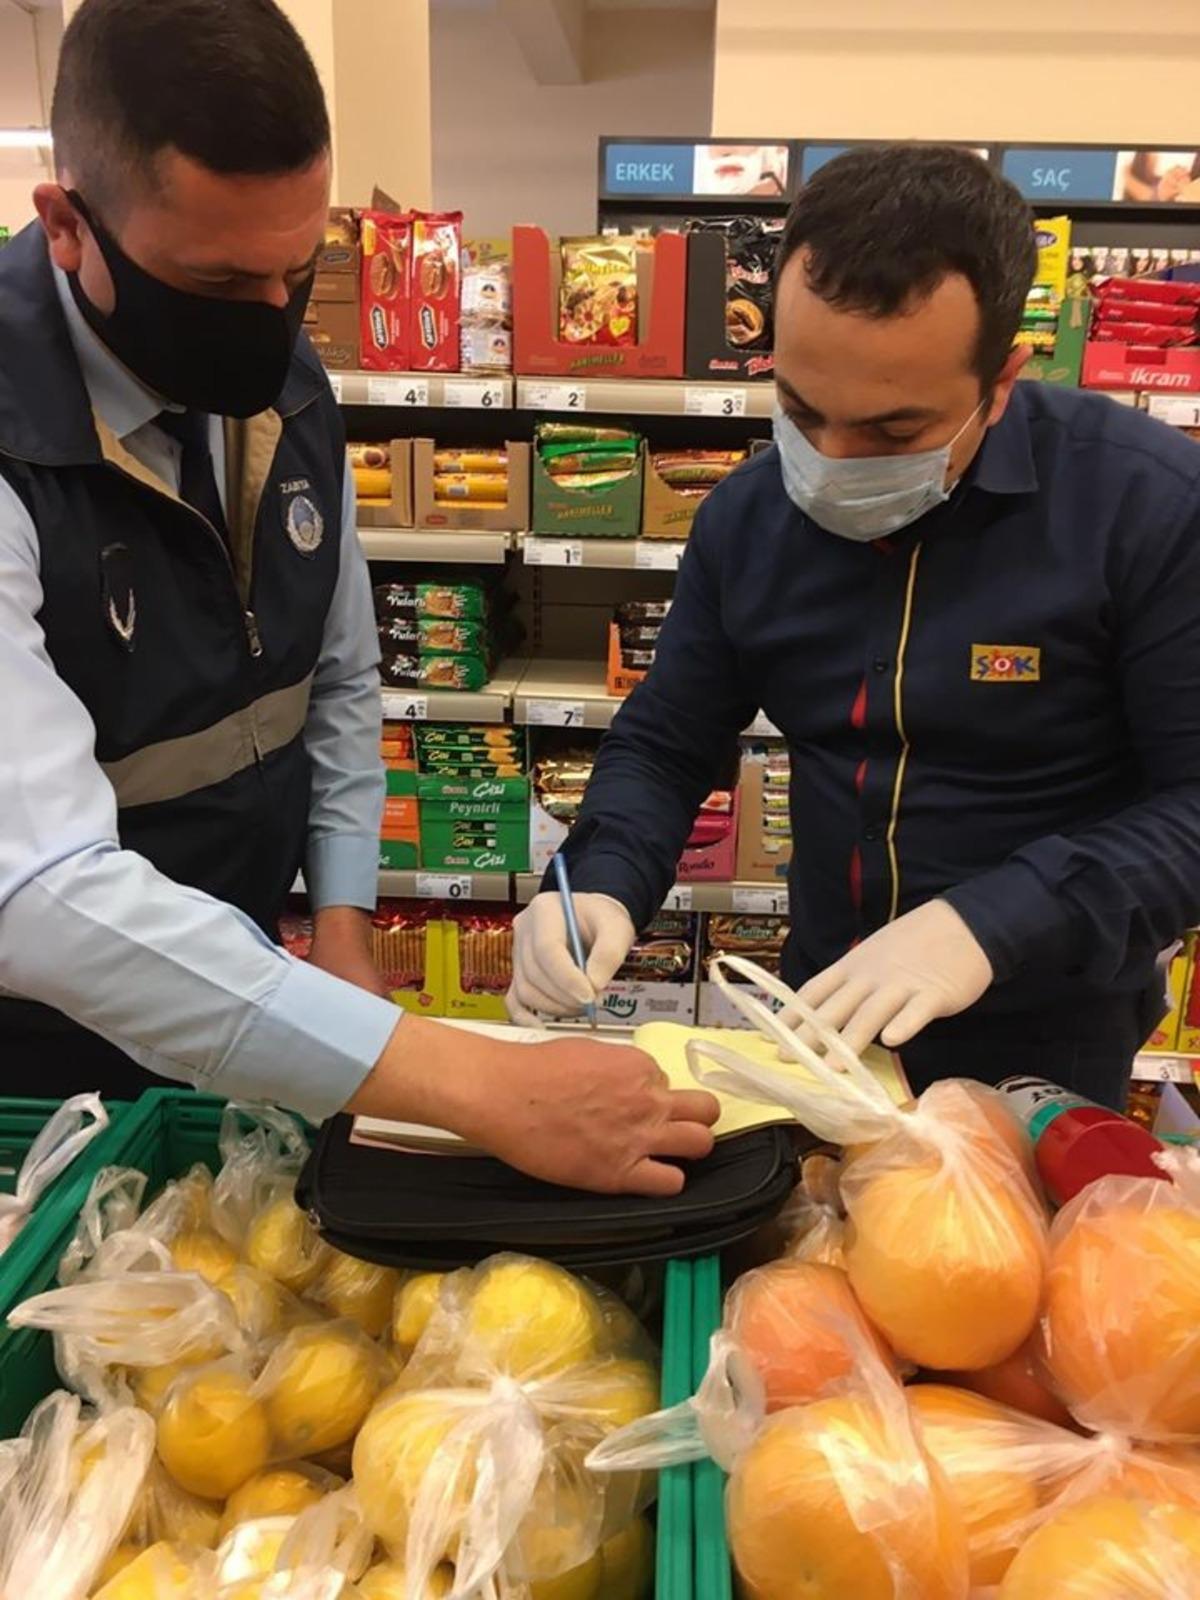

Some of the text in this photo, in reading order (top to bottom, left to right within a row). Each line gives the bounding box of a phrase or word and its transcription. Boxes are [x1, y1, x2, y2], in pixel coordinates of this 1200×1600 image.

[616, 162, 674, 181] ERKEK
[1031, 167, 1071, 191] SAÇ
[564, 711, 574, 725] 7
[450, 801, 500, 816] Peynirli
[449, 883, 461, 898] 0
